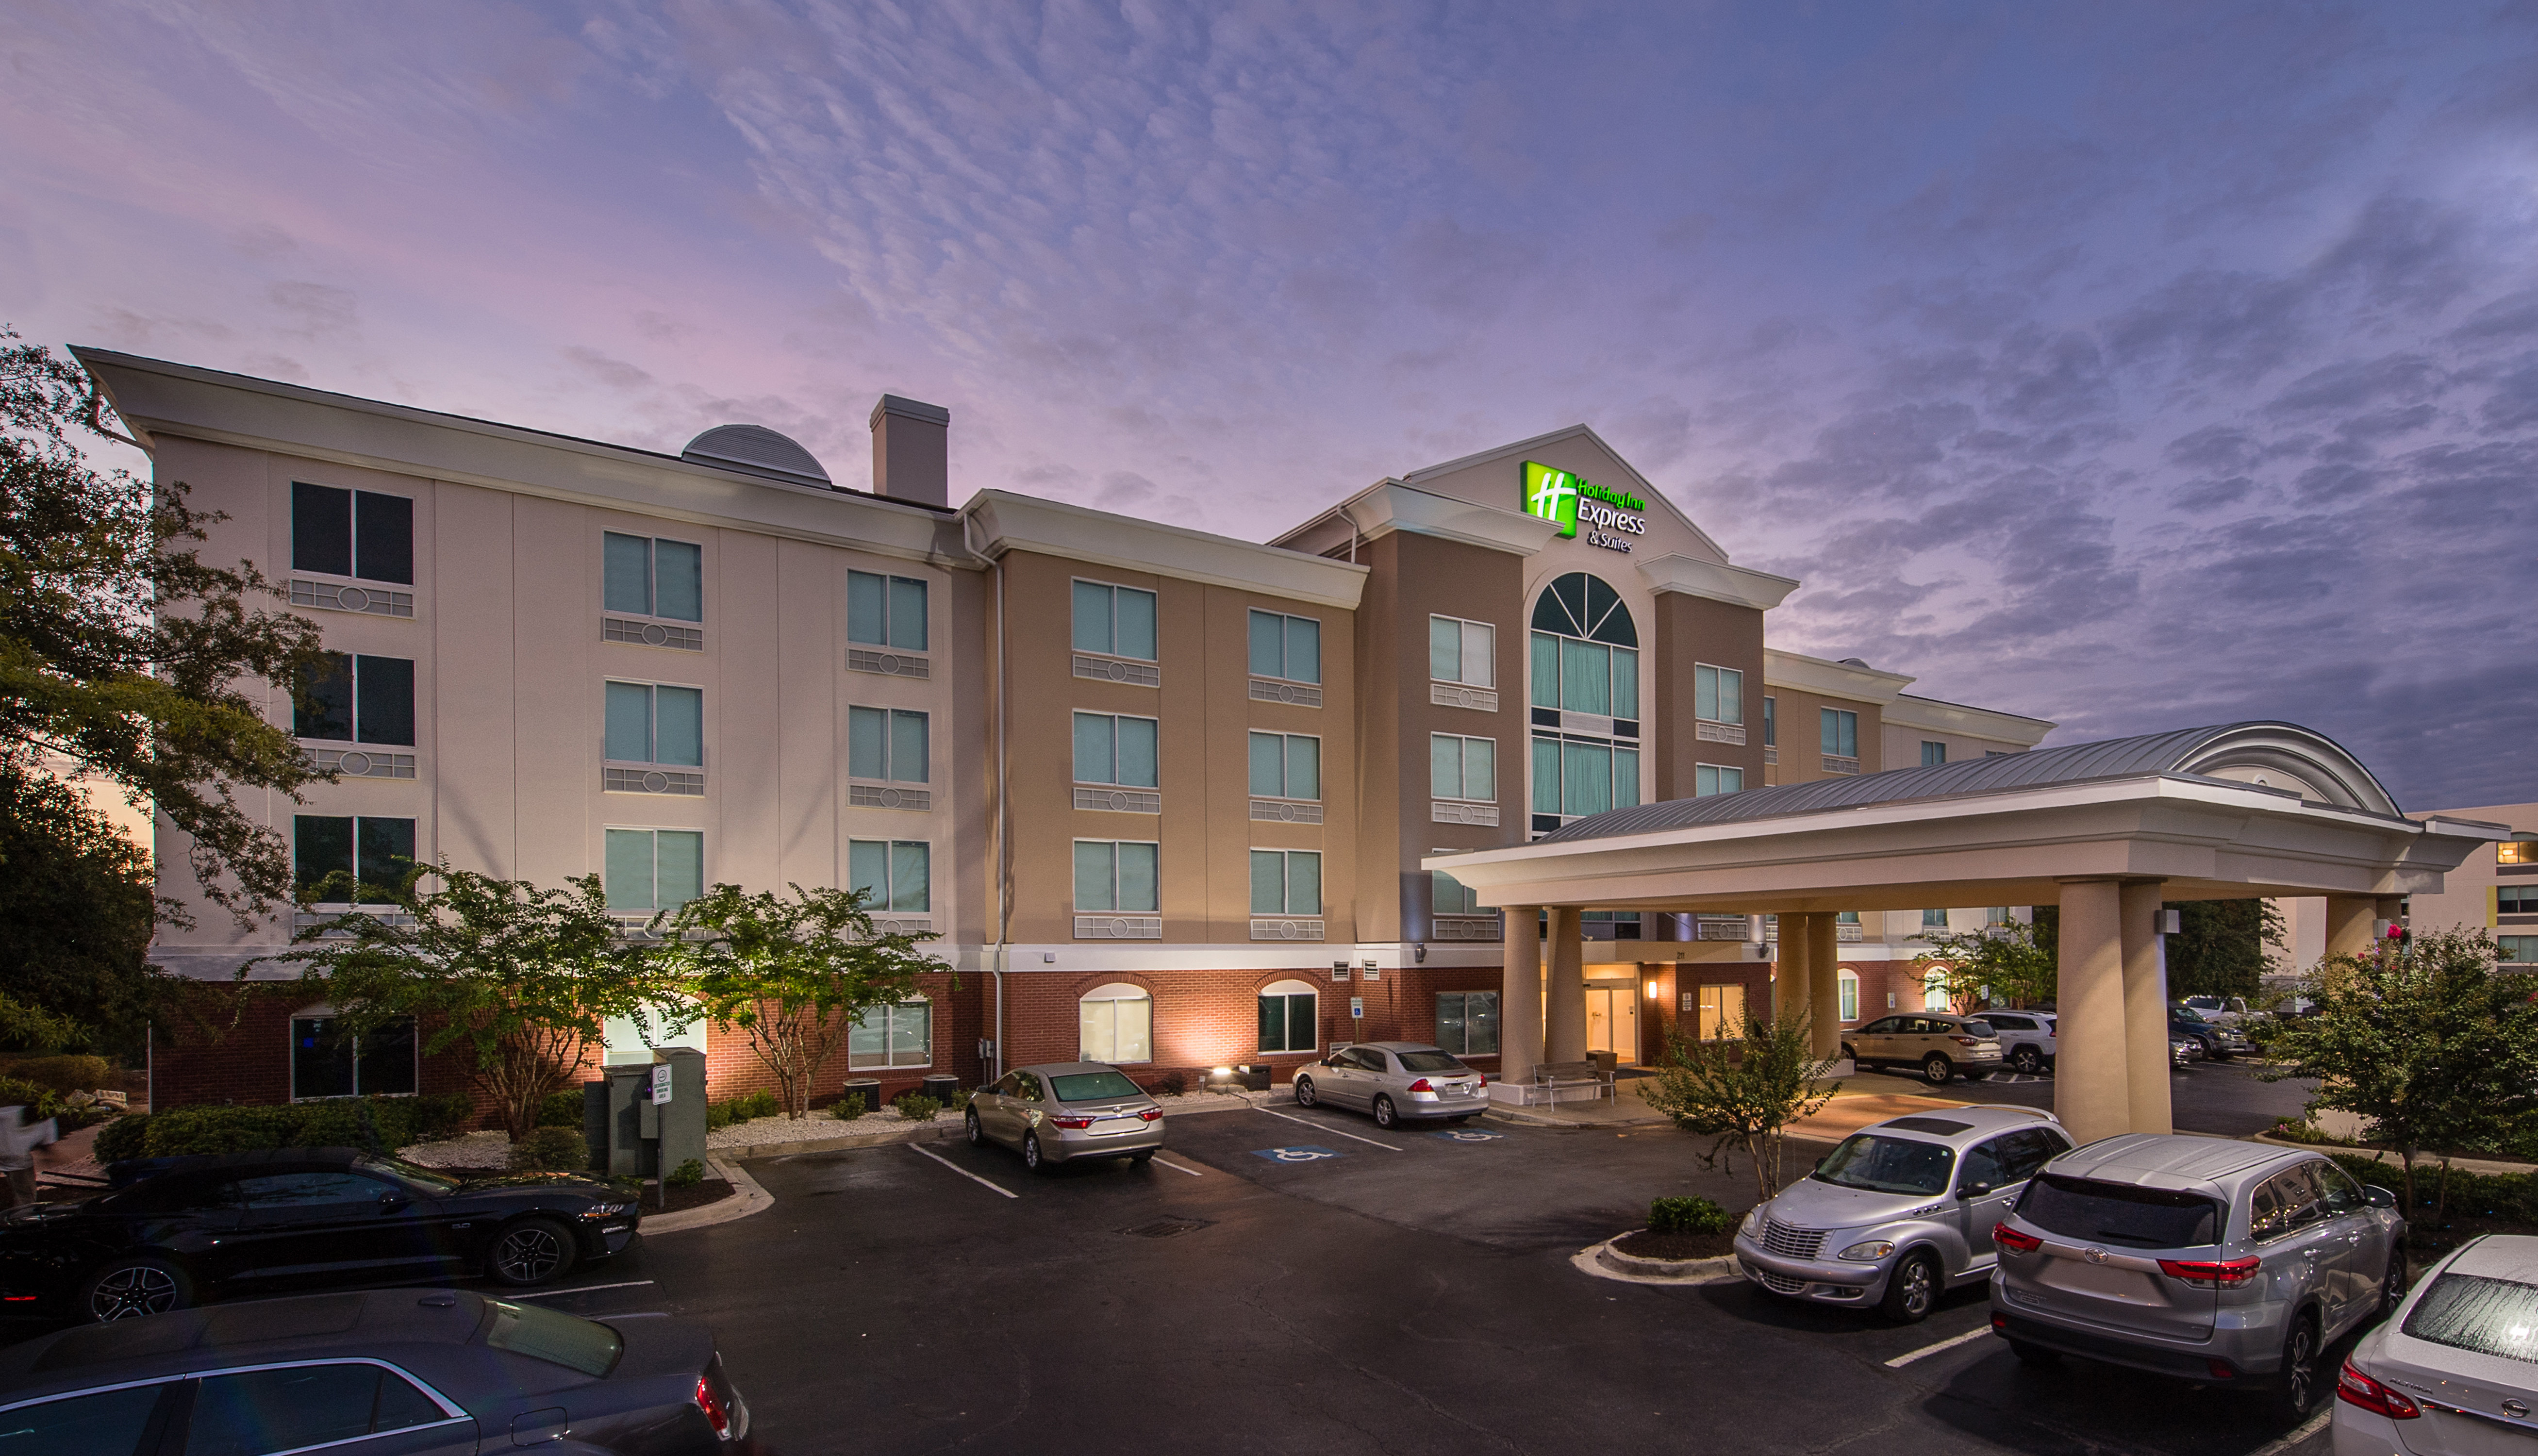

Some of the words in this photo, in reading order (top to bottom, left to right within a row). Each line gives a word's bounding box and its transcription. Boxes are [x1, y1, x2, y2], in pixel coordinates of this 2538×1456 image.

[1577, 478, 1626, 509] Holiday
[1626, 491, 1645, 511] Inn
[1577, 496, 1645, 534] Express
[1590, 530, 1598, 545] &
[1600, 533, 1633, 553] Suites
[2389, 1378, 2433, 1395] ALTIMA
